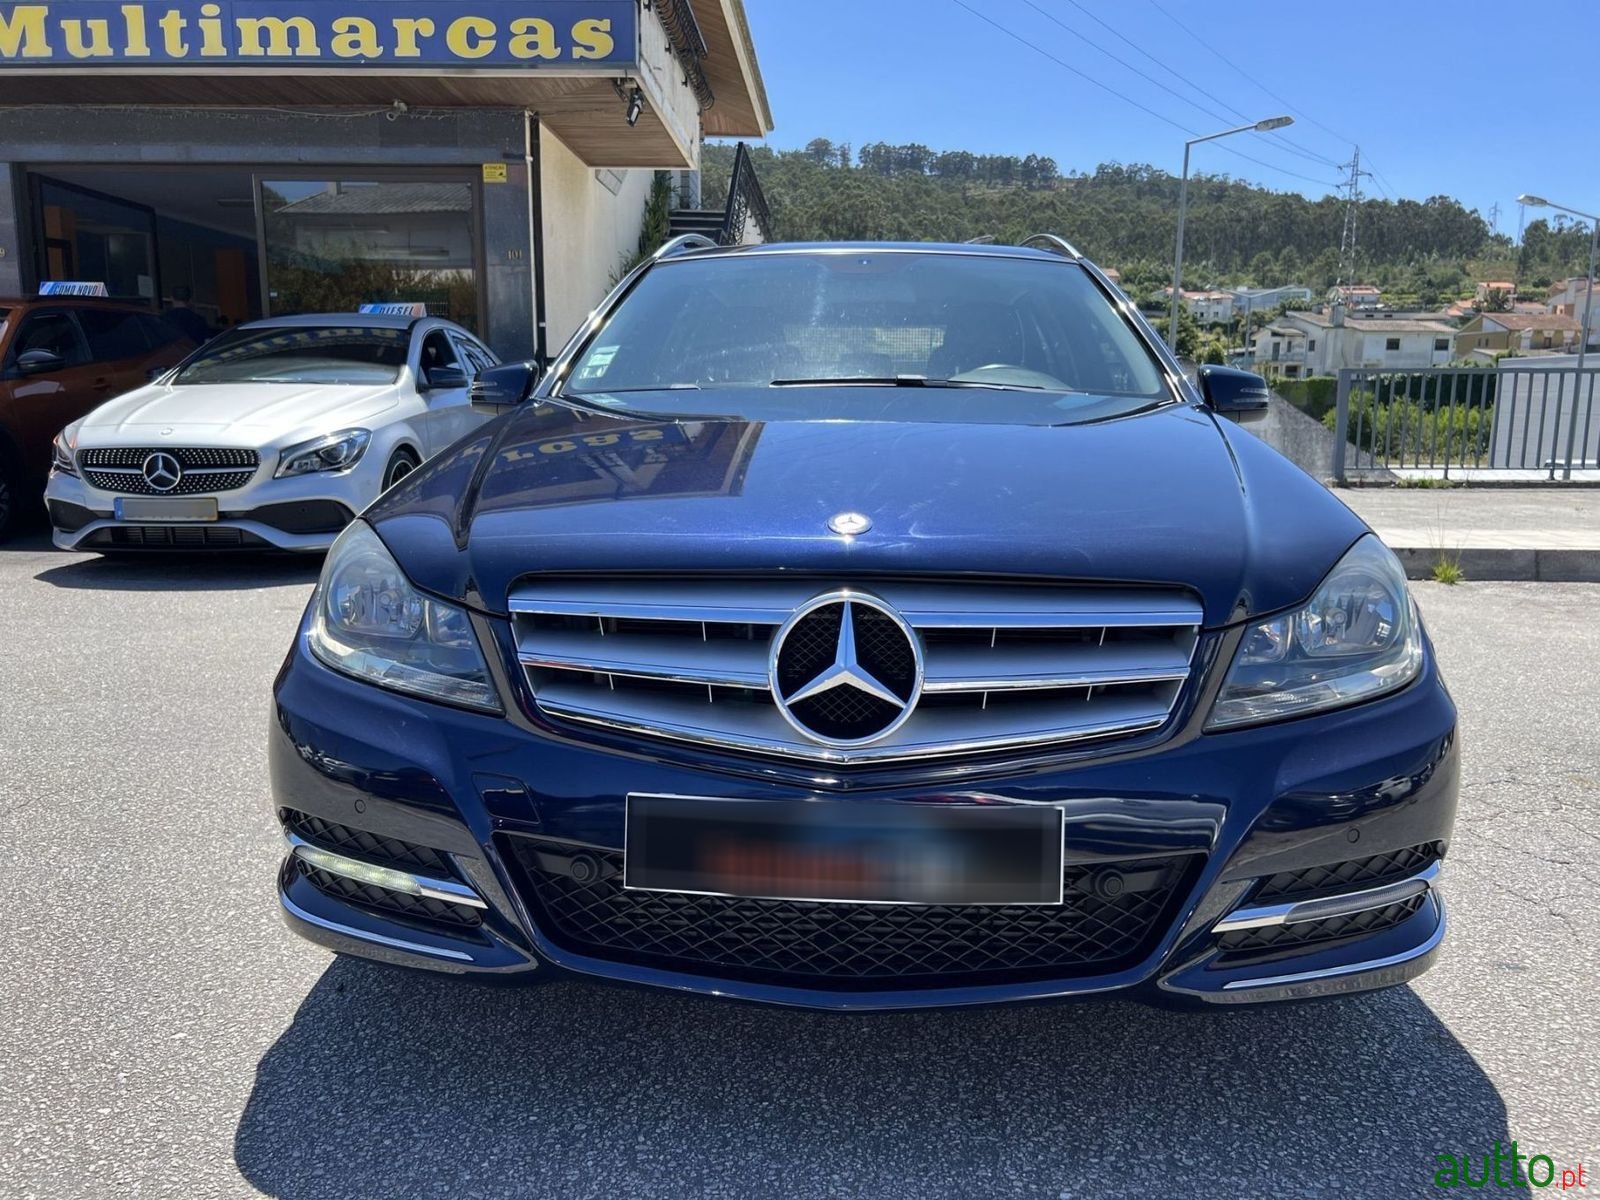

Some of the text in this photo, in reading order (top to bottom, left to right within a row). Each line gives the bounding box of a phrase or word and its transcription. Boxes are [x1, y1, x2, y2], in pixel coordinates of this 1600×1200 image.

[0, 5, 615, 59] Multimarcas
[53, 284, 98, 296] COMO NOVO
